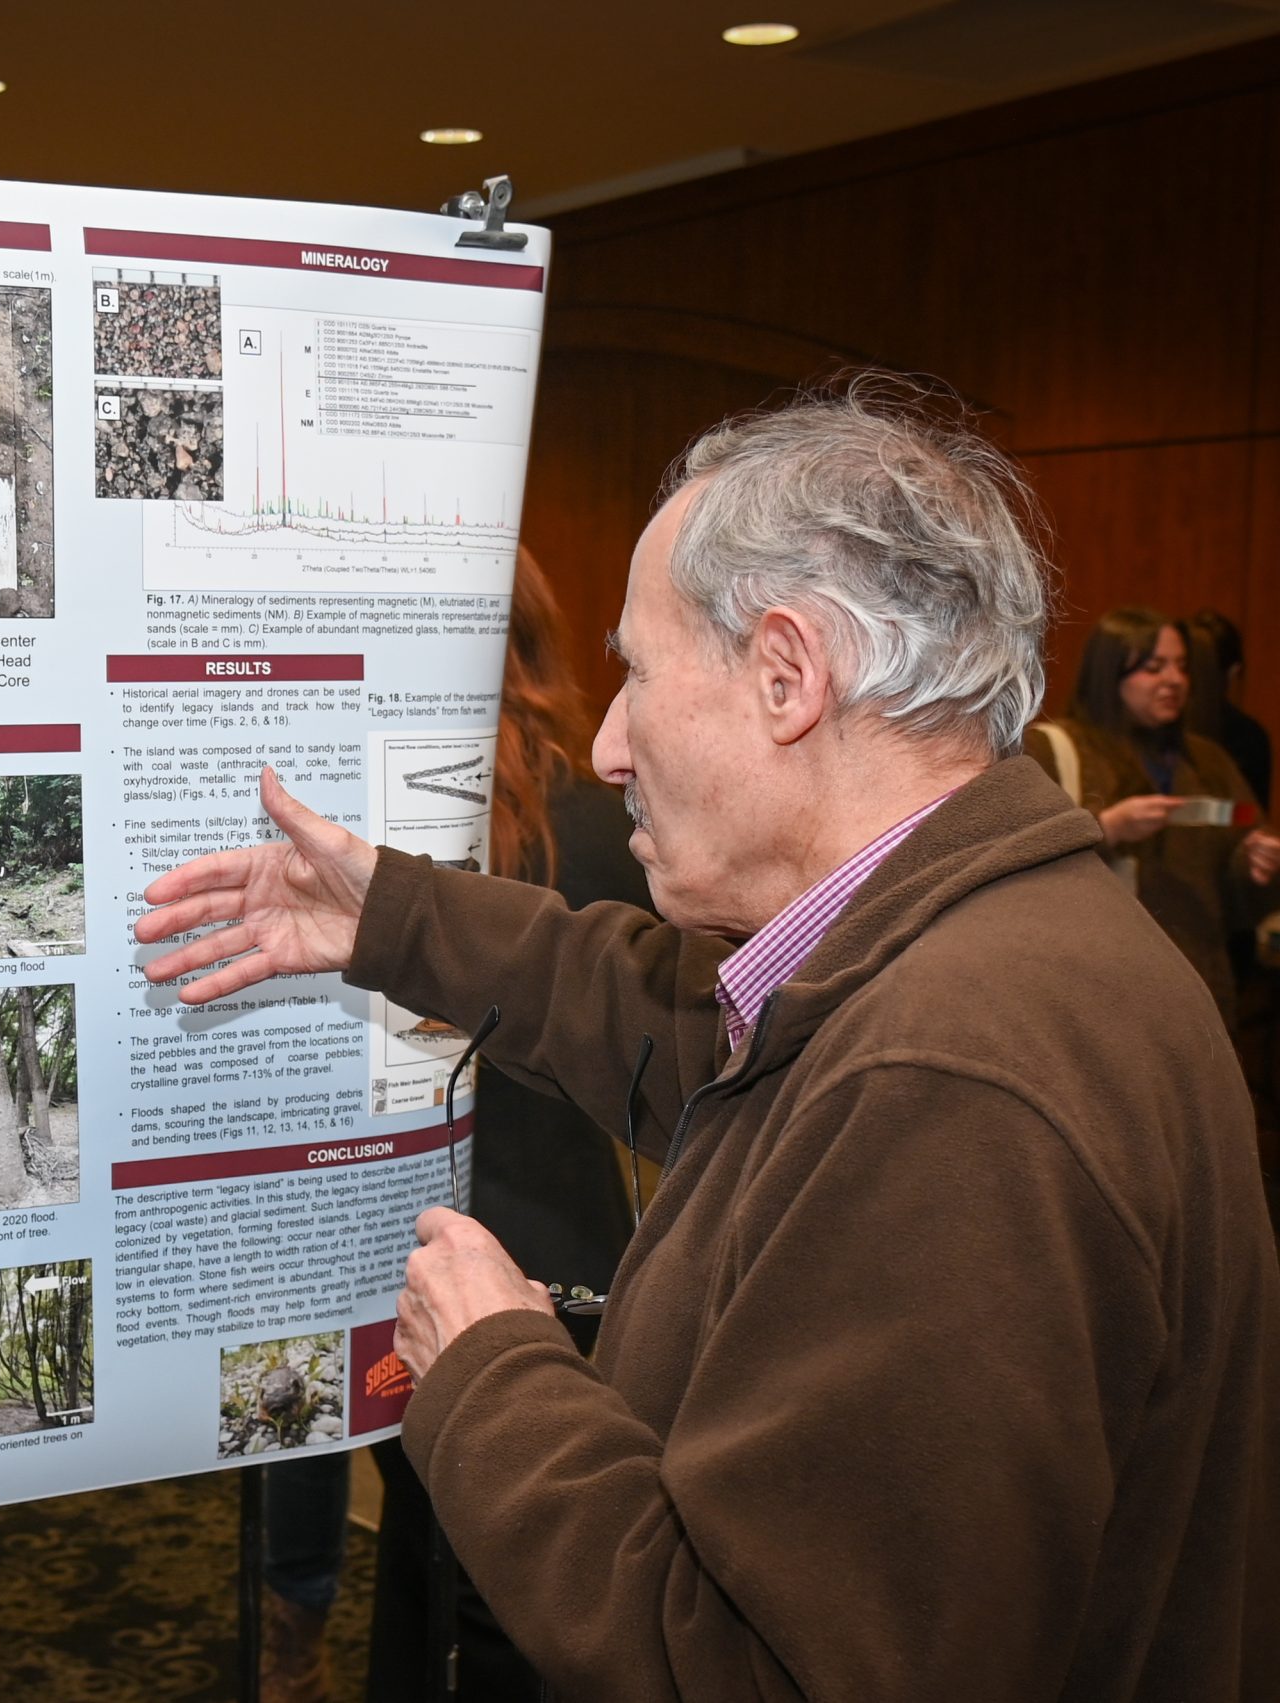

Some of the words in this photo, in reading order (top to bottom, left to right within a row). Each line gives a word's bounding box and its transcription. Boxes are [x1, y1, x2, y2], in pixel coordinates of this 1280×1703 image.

[301, 250, 389, 272] MINERALOGY
[101, 294, 115, 307] B.
[243, 336, 258, 349] A.
[304, 345, 312, 354] M
[102, 402, 116, 415] C.
[300, 419, 314, 427] NM
[147, 637, 176, 650] (scale
[179, 638, 188, 647] in
[191, 637, 198, 648] B
[201, 638, 219, 648] and
[222, 637, 230, 648] C
[233, 638, 240, 648] is
[243, 638, 267, 649] mm).
[205, 661, 271, 675] RESULTS
[122, 688, 168, 698] Historical
[171, 687, 199, 698] aerial
[202, 687, 241, 700] imagery
[245, 687, 263, 697] and
[266, 687, 299, 697] drones
[302, 688, 319, 696] can
[323, 687, 334, 696] be
[338, 686, 360, 696] used
[19, 960, 44, 971] flood
[307, 1140, 393, 1163] CONCLUSION
[2, 1213, 27, 1226] 2020
[30, 1210, 57, 1223] flood.
[62, 1275, 88, 1286] Flow
[116, 1333, 168, 1348] vegetation,
[171, 1329, 191, 1340] they
[194, 1327, 214, 1336] may
[216, 1320, 254, 1333] stabilize
[256, 1319, 265, 1327] to
[267, 1316, 285, 1326] trap
[287, 1313, 311, 1323] more
[0, 1435, 40, 1450] oriented
[42, 1433, 67, 1444] trees
[70, 1431, 82, 1440] on
